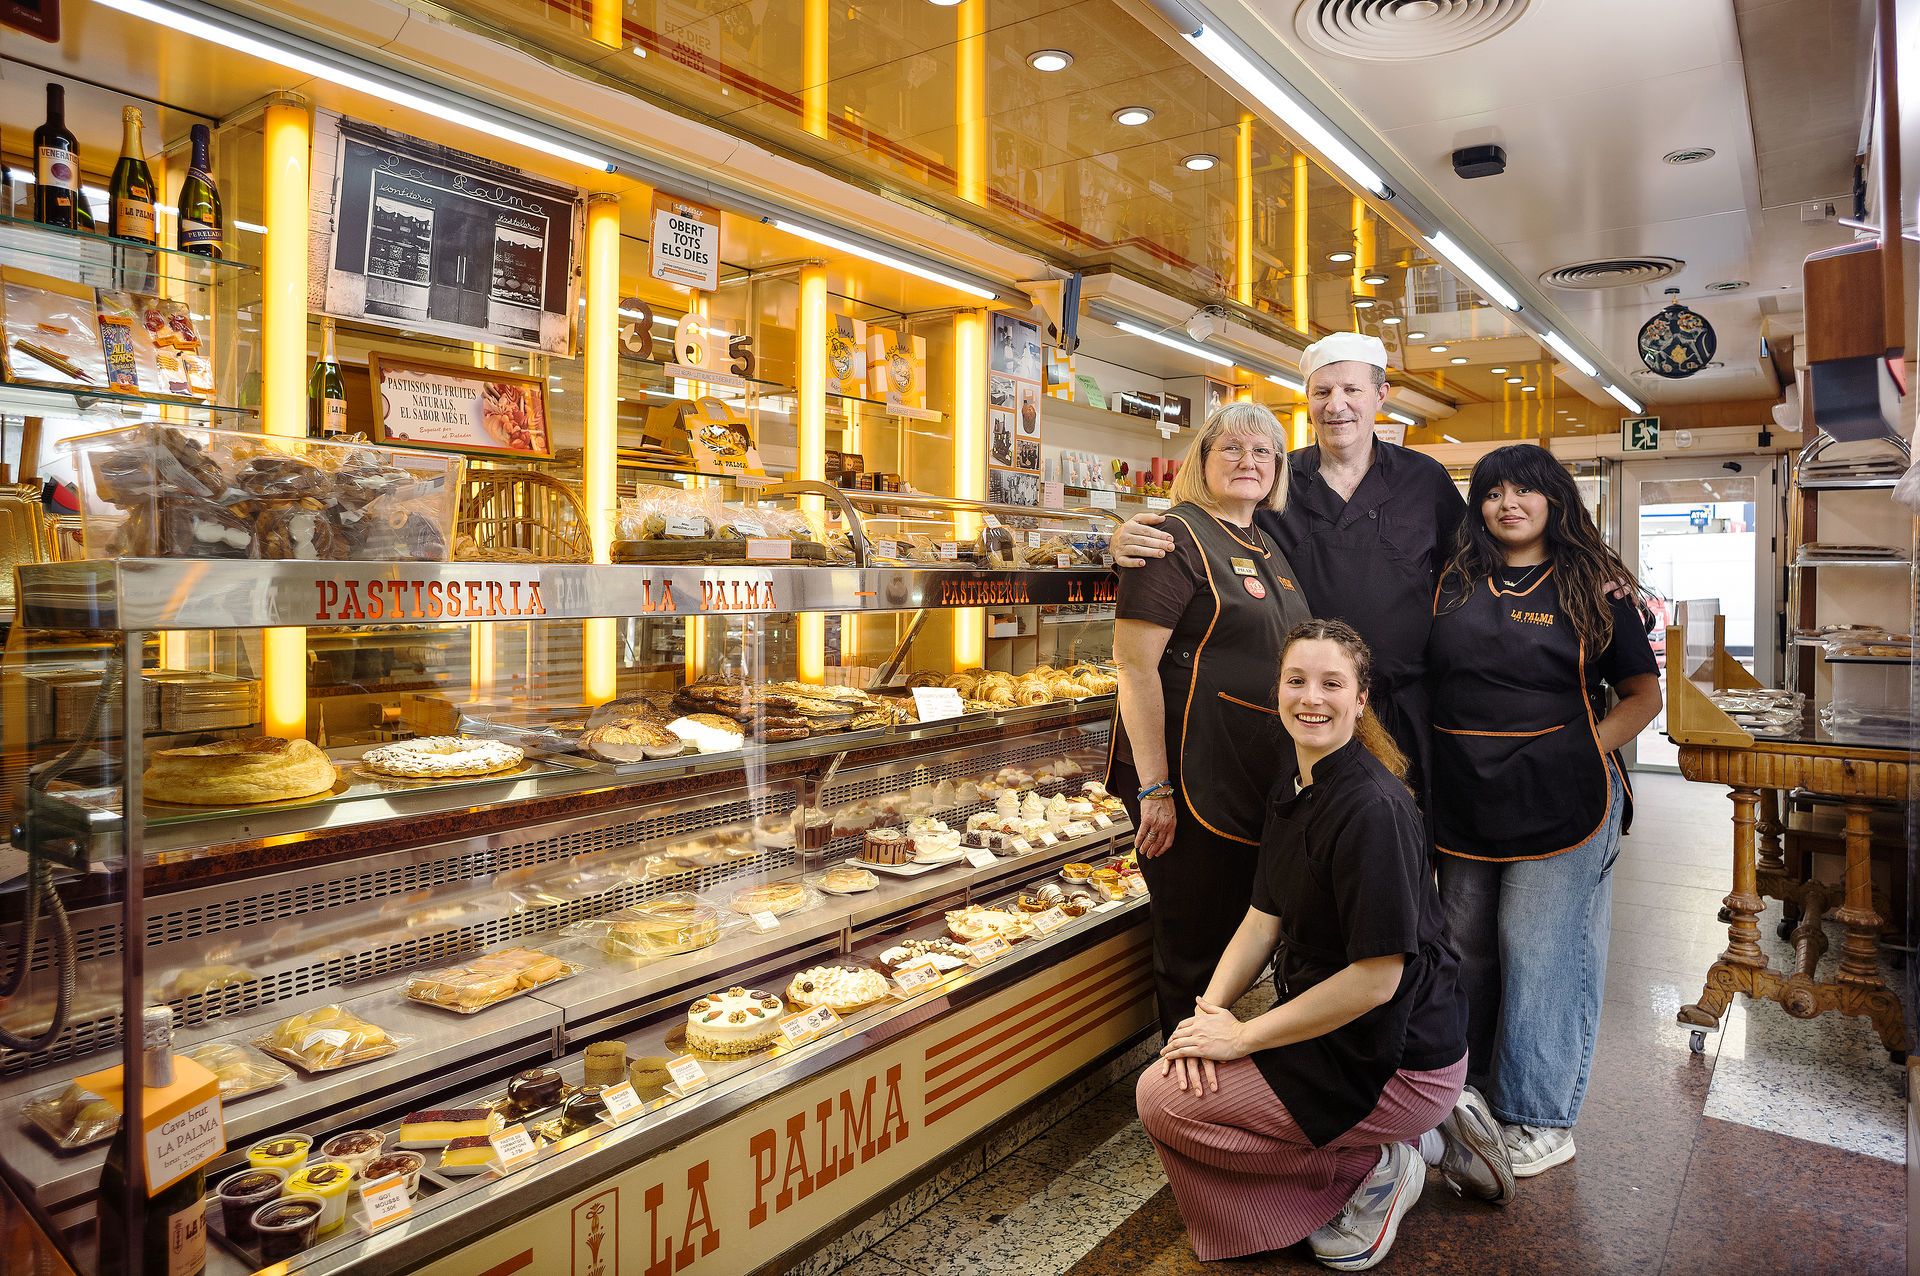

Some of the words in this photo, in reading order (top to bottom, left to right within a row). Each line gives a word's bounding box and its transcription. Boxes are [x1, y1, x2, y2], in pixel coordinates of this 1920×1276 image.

[452, 173, 545, 216] Palma
[669, 218, 704, 238] OBERT
[673, 232, 701, 250] TOTS
[662, 242, 681, 258] ELS
[683, 248, 708, 265] DIES
[110, 353, 134, 364] STARS
[113, 344, 126, 354] ALL
[388, 377, 430, 395] PASTISSOS
[432, 383, 443, 396] DE
[444, 385, 476, 400] FRUITES
[400, 406, 411, 419] EL
[413, 408, 440, 422] SABOR
[725, 460, 748, 469] PALMA
[315, 580, 547, 620] PASTISSERIA
[641, 579, 677, 613] LA
[700, 580, 777, 611] PALMA
[941, 580, 1030, 605] PASTISSERIA
[1068, 580, 1084, 602] LA
[1511, 609, 1522, 620] LA
[1524, 611, 1554, 625] PALMA
[162, 1118, 186, 1136] Cava
[188, 1106, 209, 1123] brut
[158, 1141, 175, 1159] LA
[176, 1117, 219, 1148] PALMA
[644, 1159, 721, 1276] LA
[749, 1063, 910, 1230] PALMA
[378, 1192, 391, 1201] GOT
